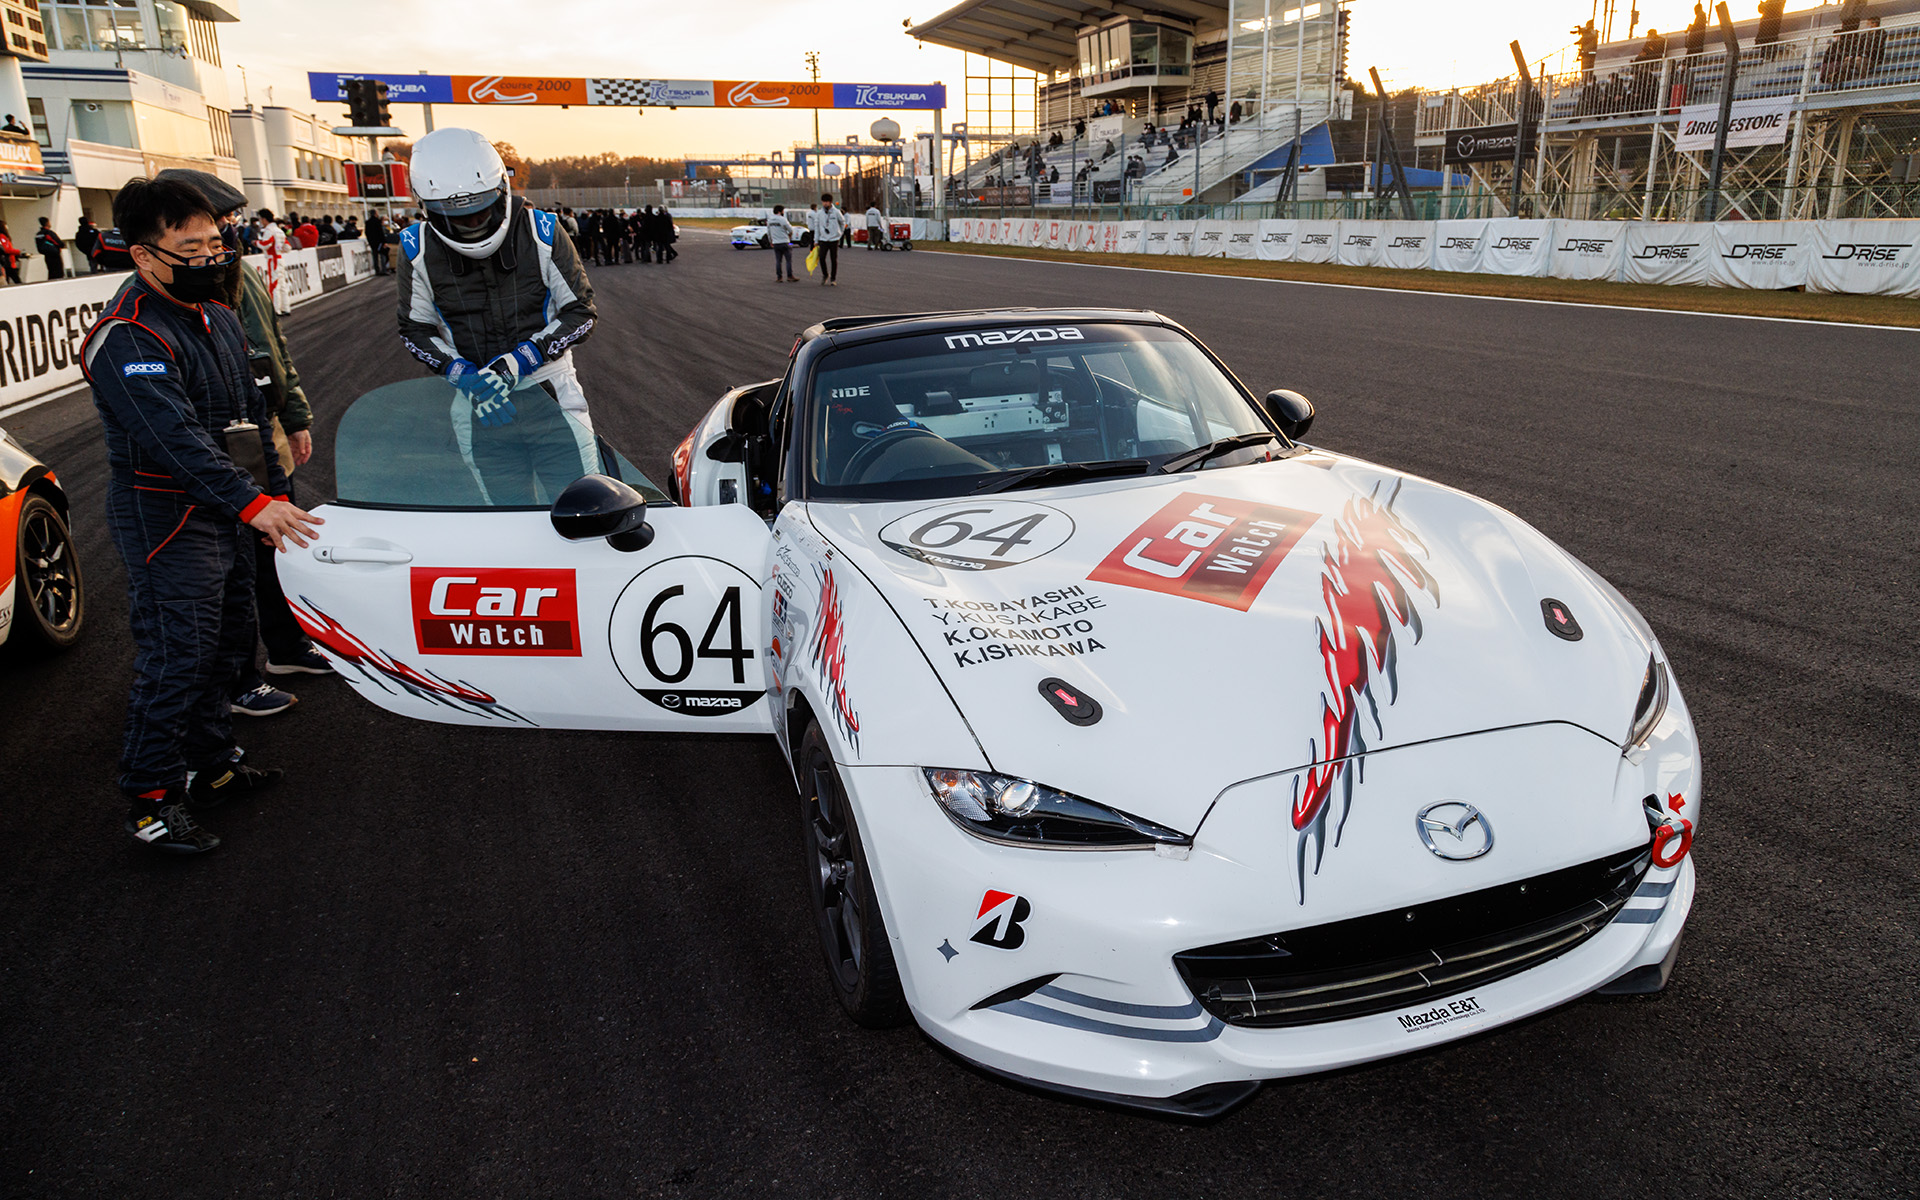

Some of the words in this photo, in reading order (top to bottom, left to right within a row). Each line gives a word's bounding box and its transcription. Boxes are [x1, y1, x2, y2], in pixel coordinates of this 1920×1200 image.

[500, 81, 533, 90] course
[536, 80, 571, 91] 2000
[788, 85, 820, 95] 2000
[1684, 113, 1783, 136] BRIDESTONE
[1344, 235, 1377, 247] D-RISE
[1388, 237, 1426, 248] D-RISE
[1440, 237, 1480, 250] D-RISE
[1491, 237, 1539, 250] D-RISE
[1558, 239, 1613, 253] D-RISE
[1633, 244, 1699, 259] D-RISE
[1722, 244, 1797, 259] D-RISE
[1822, 244, 1912, 261] D-RISE
[1858, 261, 1910, 269] www.d-rise.jp
[909, 509, 1049, 557] 64
[1123, 502, 1237, 579] Car
[1206, 519, 1287, 575] Watch
[429, 576, 558, 617] Car
[923, 585, 1085, 613] T.KOBAYASHI
[449, 622, 544, 646] Watch
[640, 584, 755, 685] 64
[943, 619, 1094, 646] K.OKAMOTO
[953, 637, 1107, 668] K.ISHIKAWA
[1397, 1008, 1451, 1029] Mazda
[1447, 996, 1481, 1015] E&T
